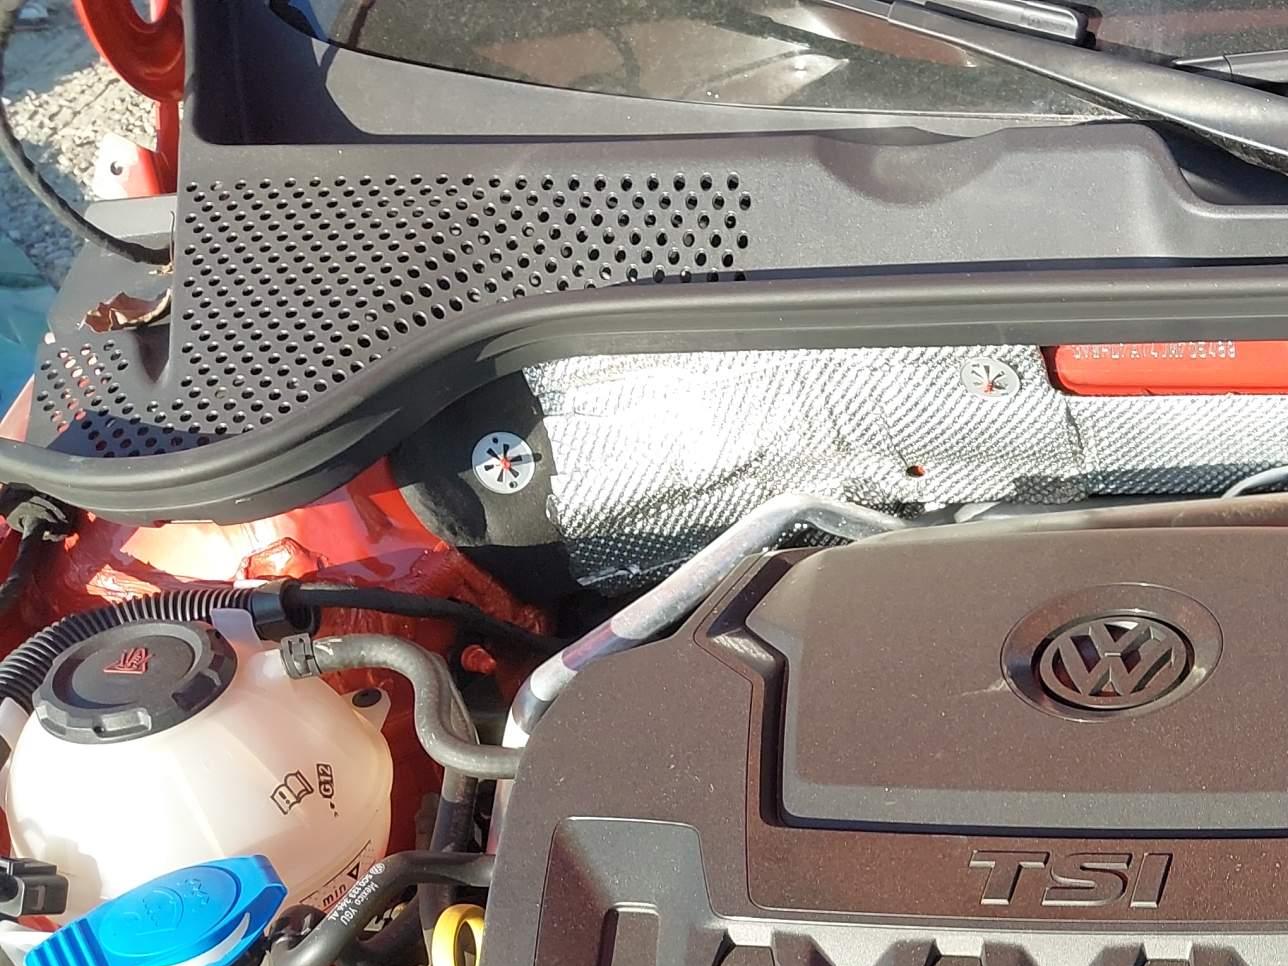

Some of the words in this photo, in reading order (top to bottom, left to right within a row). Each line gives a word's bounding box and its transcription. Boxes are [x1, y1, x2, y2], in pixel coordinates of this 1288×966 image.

[320, 765, 333, 797] G12
[969, 849, 1173, 908] TSI
[323, 884, 346, 906] min
[355, 881, 378, 906] Mexico
